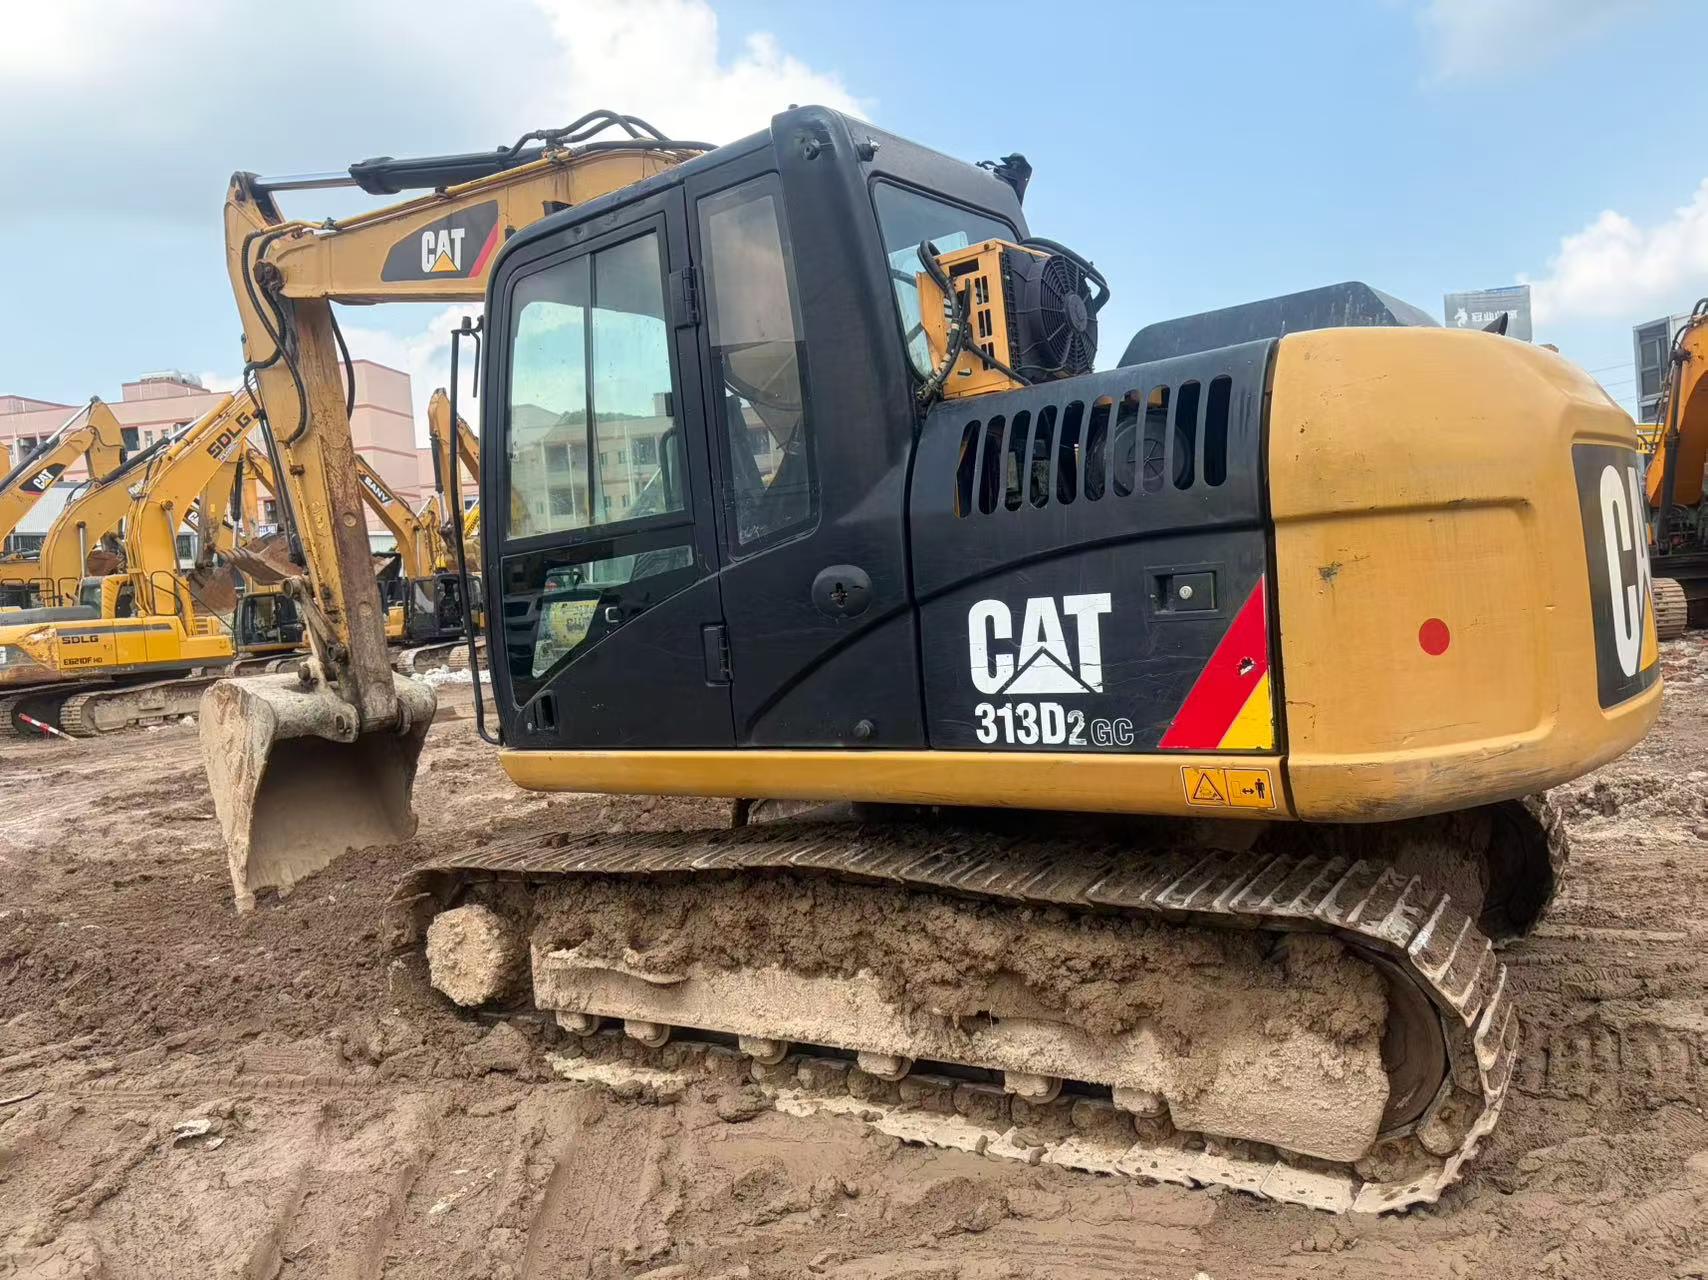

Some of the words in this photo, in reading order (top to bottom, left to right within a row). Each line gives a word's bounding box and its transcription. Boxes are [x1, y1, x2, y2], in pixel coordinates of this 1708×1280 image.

[421, 228, 465, 272] CAT
[206, 411, 253, 459] SDLG
[33, 469, 55, 490] CAT
[364, 476, 390, 502] SANY
[1600, 464, 1652, 677] CA
[61, 635, 99, 645] SDLG
[968, 592, 1112, 694] CAT
[1090, 718, 1134, 746] GC
